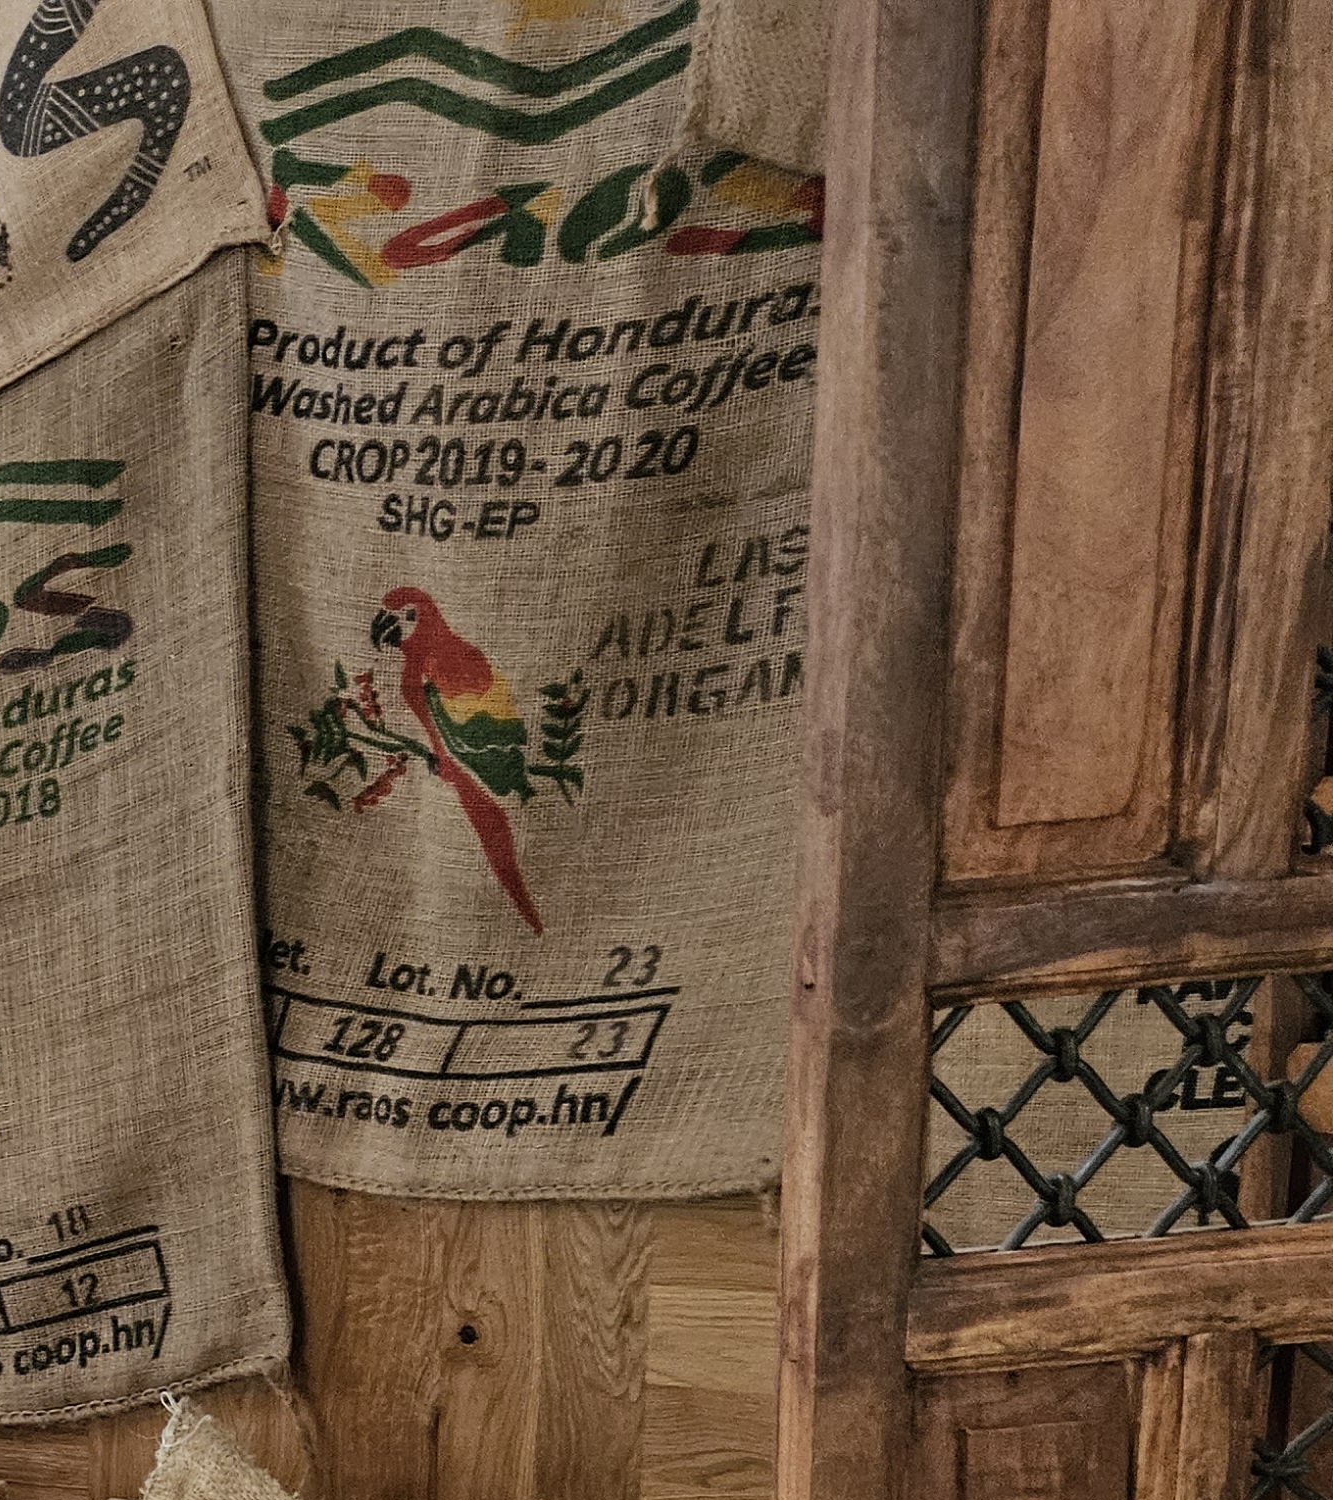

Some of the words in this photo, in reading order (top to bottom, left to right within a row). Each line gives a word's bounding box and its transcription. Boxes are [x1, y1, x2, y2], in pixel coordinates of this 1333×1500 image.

[247, 317, 423, 370] Product
[438, 320, 511, 380] of
[250, 372, 407, 425] Washed
[409, 376, 604, 425] Arabica
[625, 342, 817, 412] Coffee
[309, 437, 409, 483] CROP
[264, 931, 311, 976] et.
[367, 951, 434, 998] Lot.
[450, 964, 523, 1002] No.
[603, 945, 661, 988] 23
[324, 1016, 406, 1061] 128
[569, 1021, 627, 1060] 23
[60, 1272, 99, 1309] 12
